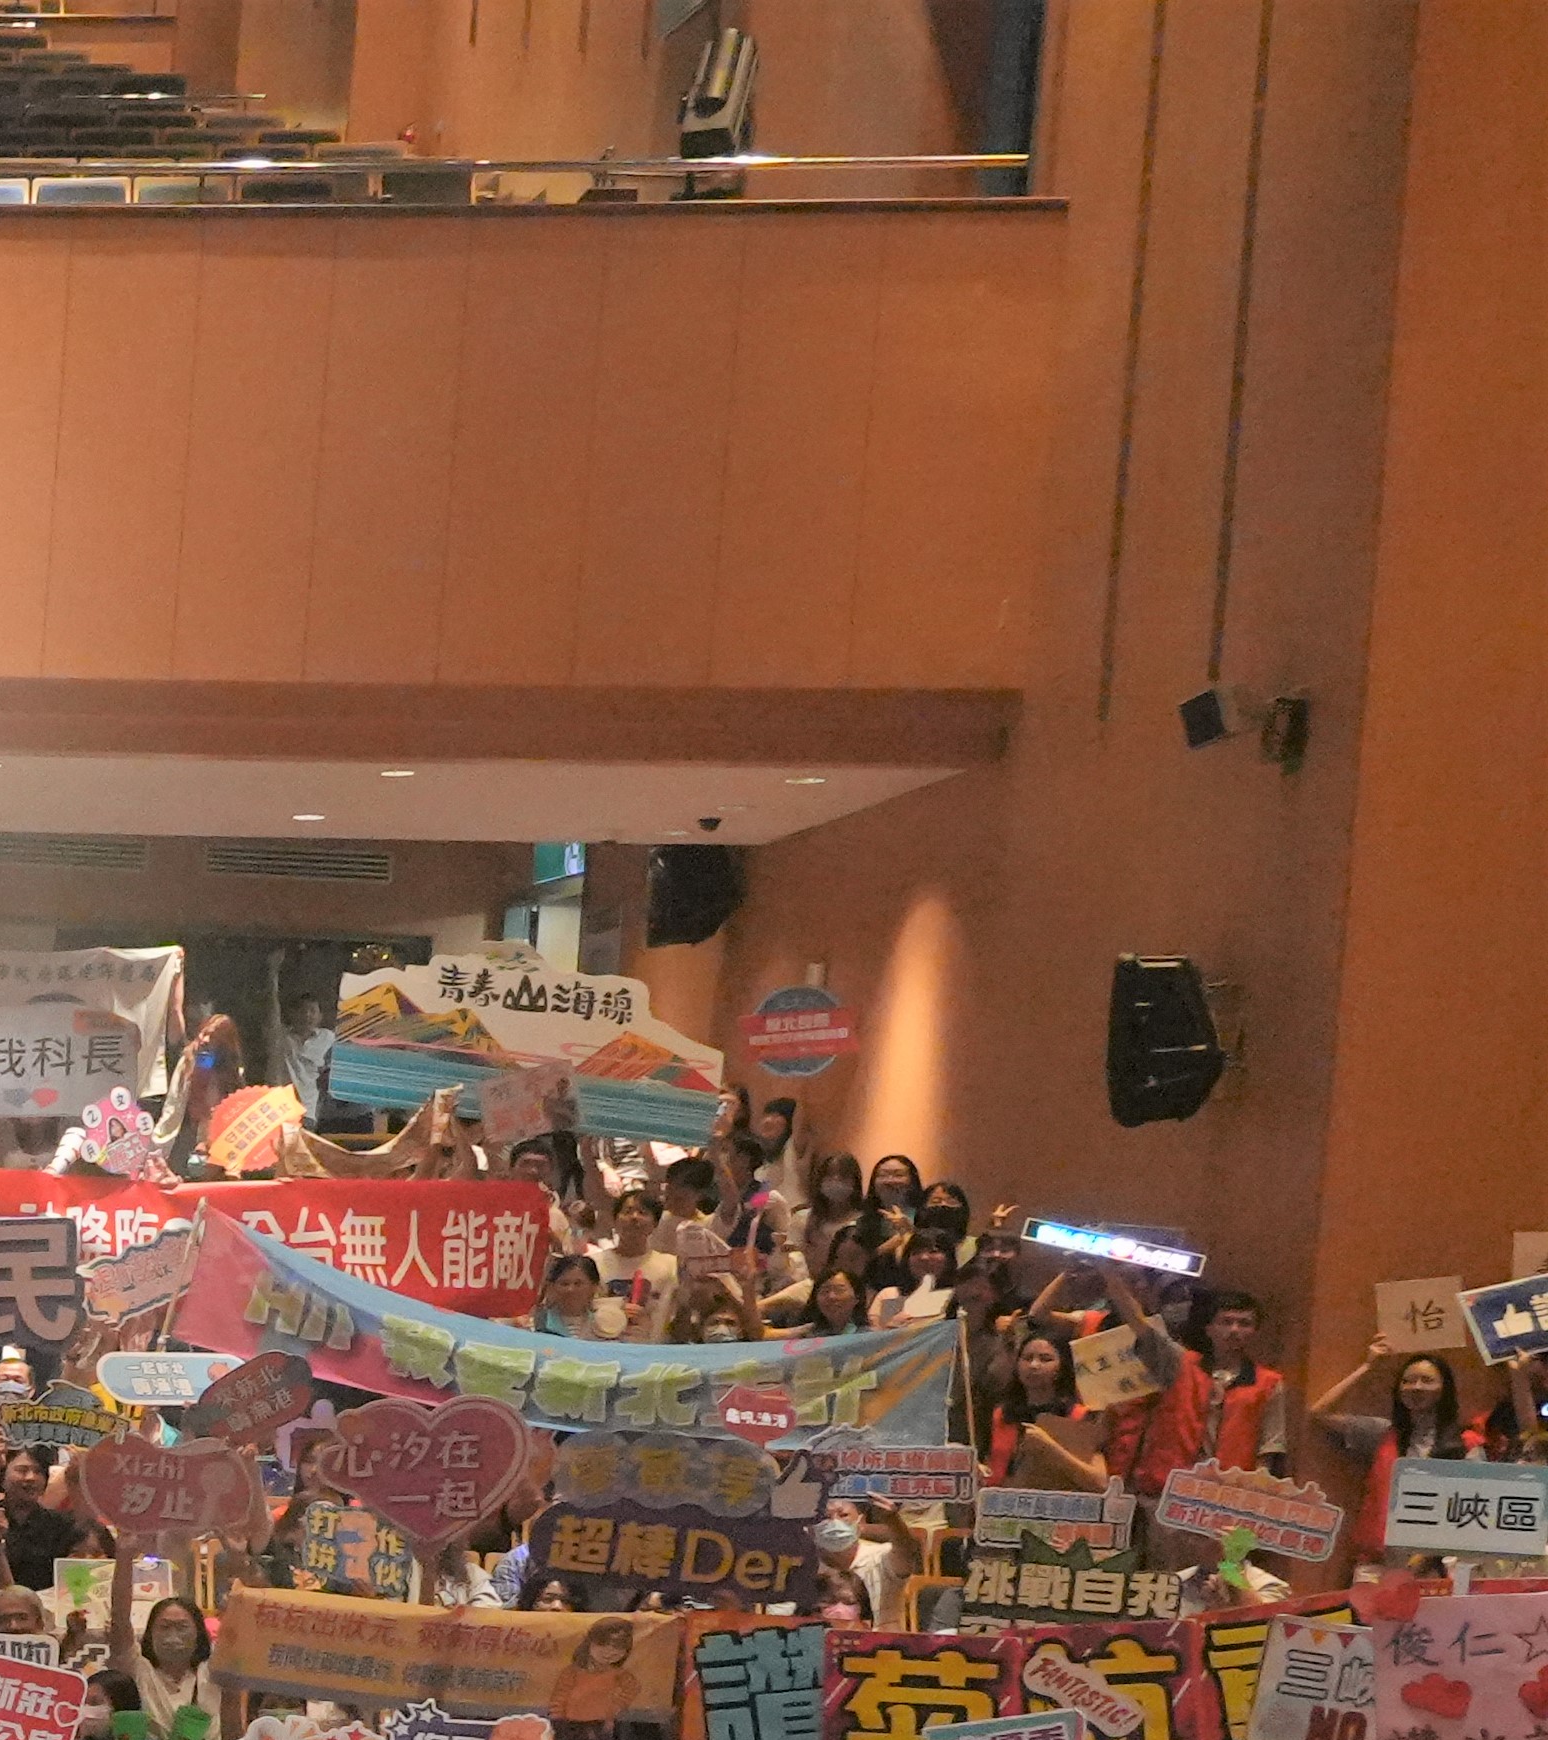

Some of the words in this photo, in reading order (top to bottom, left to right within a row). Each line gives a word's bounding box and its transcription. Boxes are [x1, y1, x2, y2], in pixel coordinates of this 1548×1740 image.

[439, 963, 633, 1027] 青春山海線
[1405, 1299, 1446, 1335] 怡
[119, 1482, 197, 1521] 汐止
[387, 1477, 478, 1516] 一起
[1395, 1489, 1540, 1531] 三峽區
[548, 1515, 803, 1592] 超棒Der
[964, 1559, 1182, 1618] 挑戰自我
[1392, 1620, 1507, 1668] 俊仁
[1029, 1657, 1139, 1728] FANTASTIC!
